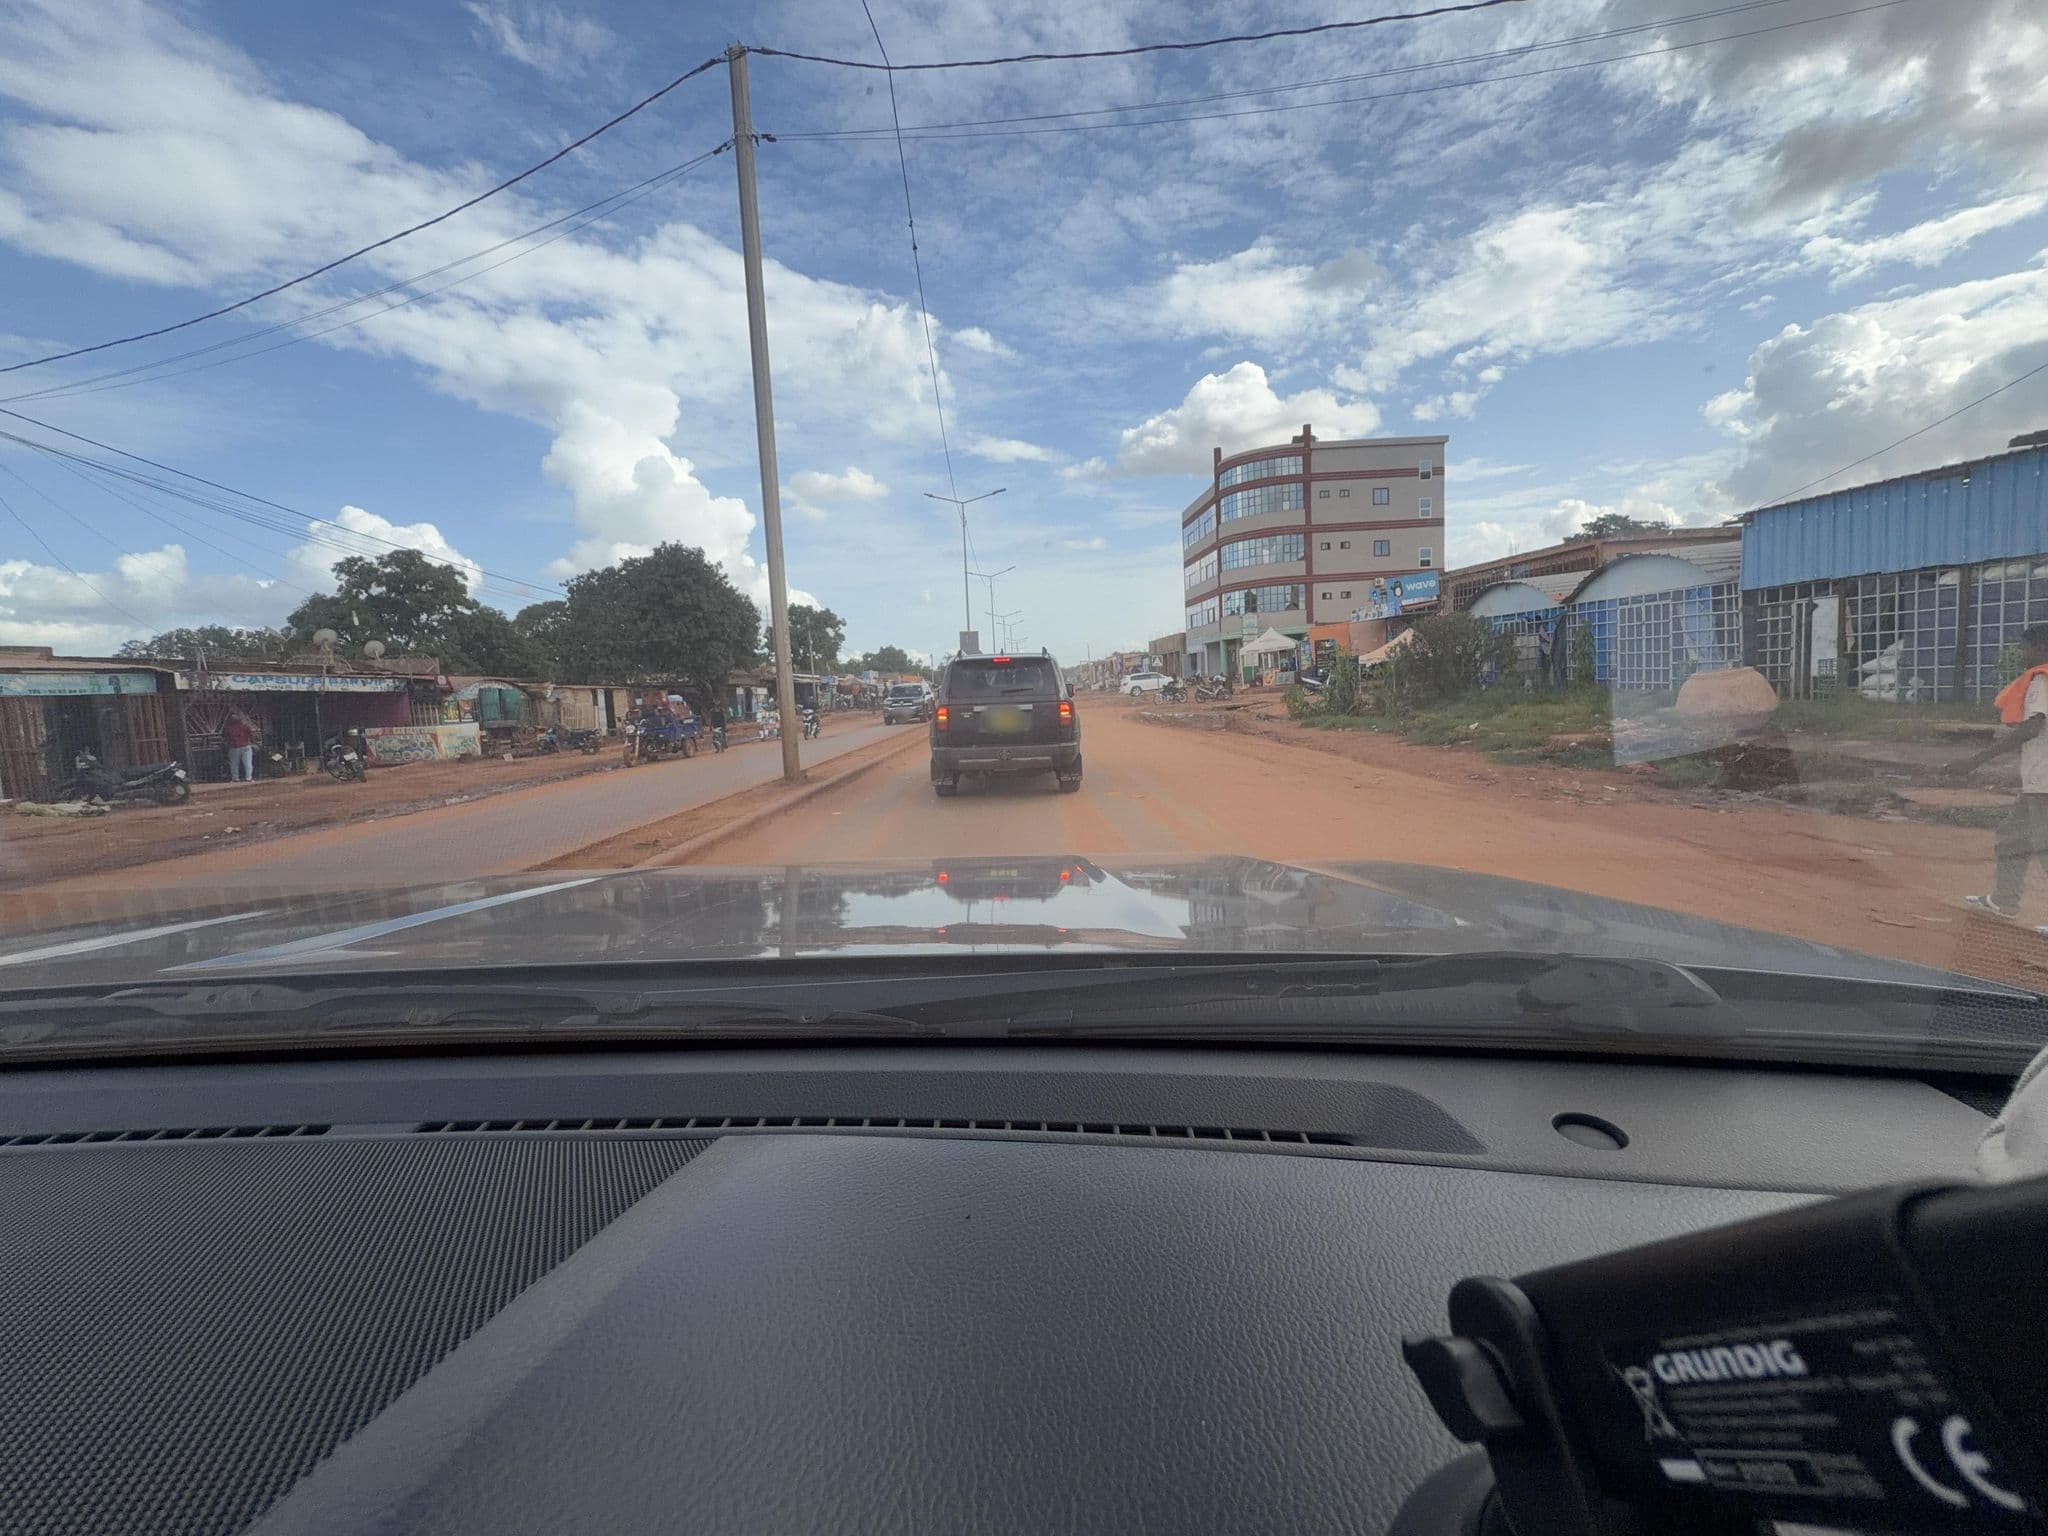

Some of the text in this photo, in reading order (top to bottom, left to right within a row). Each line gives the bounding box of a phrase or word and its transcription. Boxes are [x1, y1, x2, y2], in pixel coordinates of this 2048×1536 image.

[1406, 580, 1436, 591] wave
[232, 675, 321, 685] CAPSULE
[328, 677, 358, 686] BAR
[1652, 1339, 1809, 1384] GRUNDIG
[1890, 1414, 2027, 1512] CE
